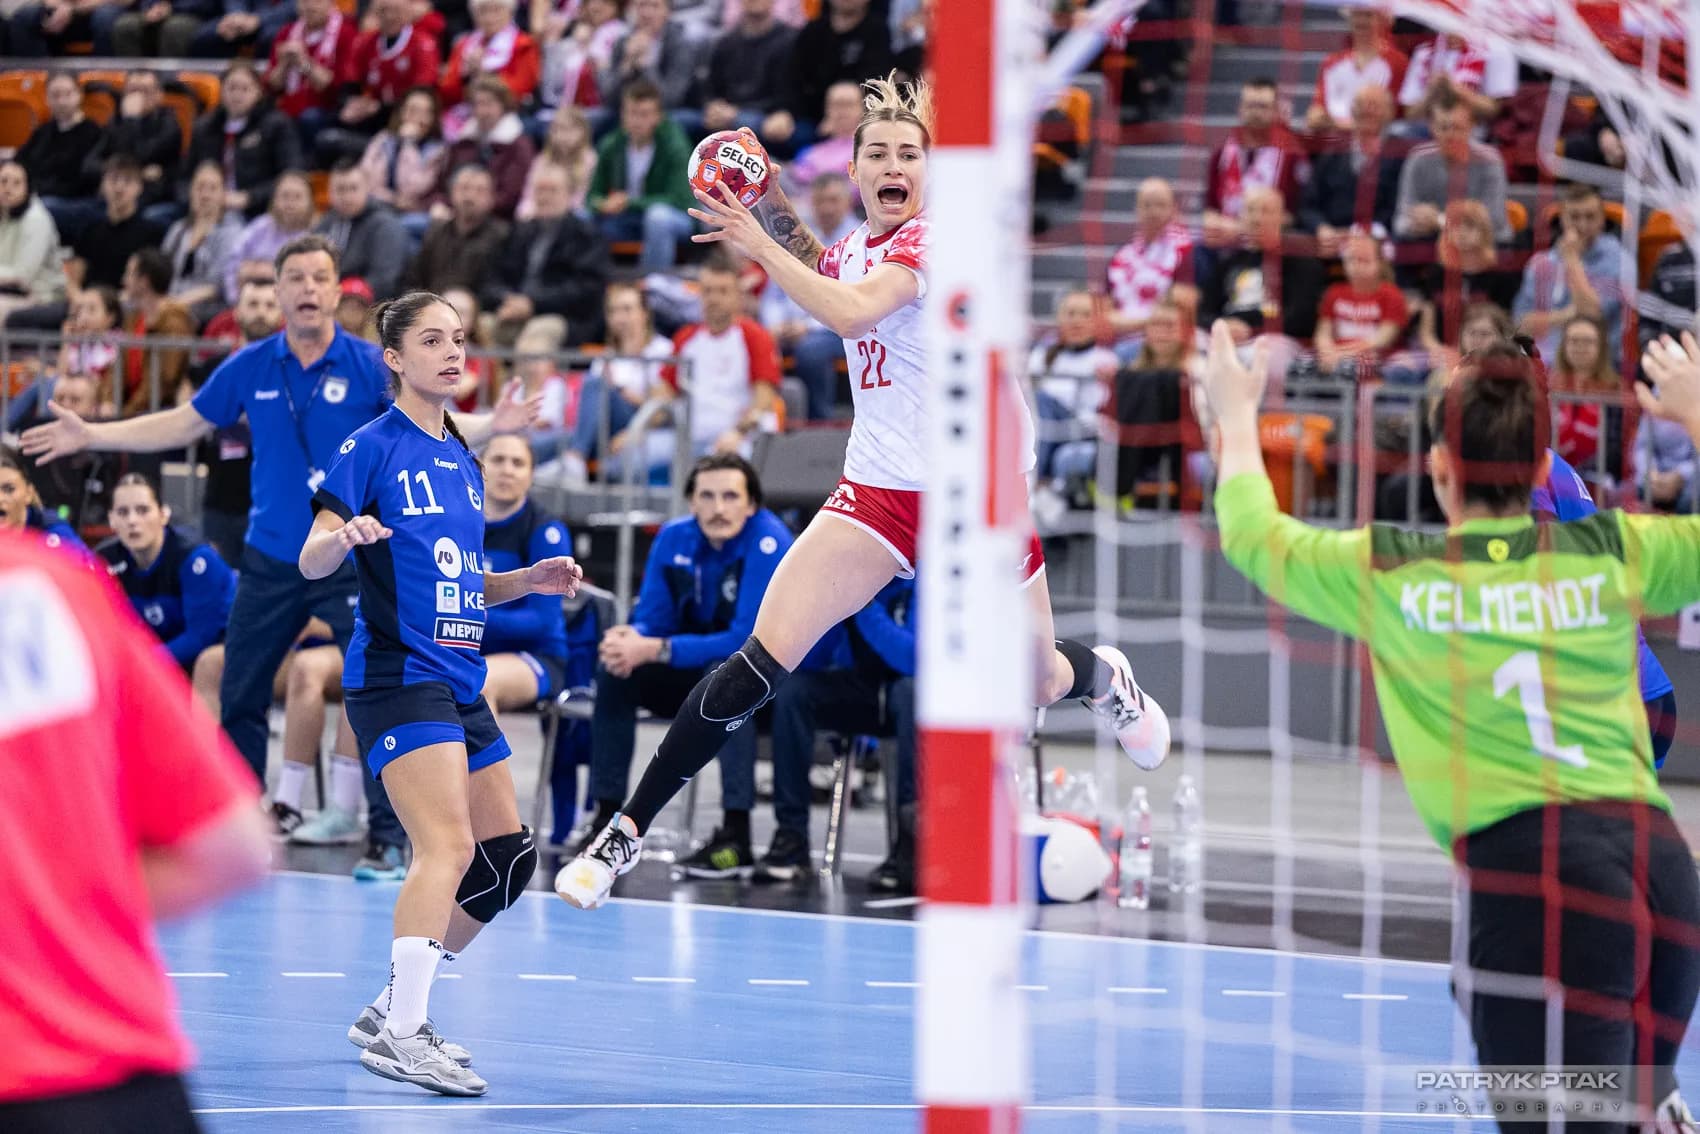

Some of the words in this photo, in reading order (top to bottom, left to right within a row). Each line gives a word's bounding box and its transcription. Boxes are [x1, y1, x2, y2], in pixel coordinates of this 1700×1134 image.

[721, 146, 764, 178] SELECT
[857, 339, 892, 390] 22
[433, 457, 459, 472] Kempa
[397, 469, 445, 516] 11
[823, 496, 856, 513] LEN
[463, 549, 485, 575] NL
[1400, 573, 1609, 634] KELMENDI
[1493, 650, 1589, 769] 1
